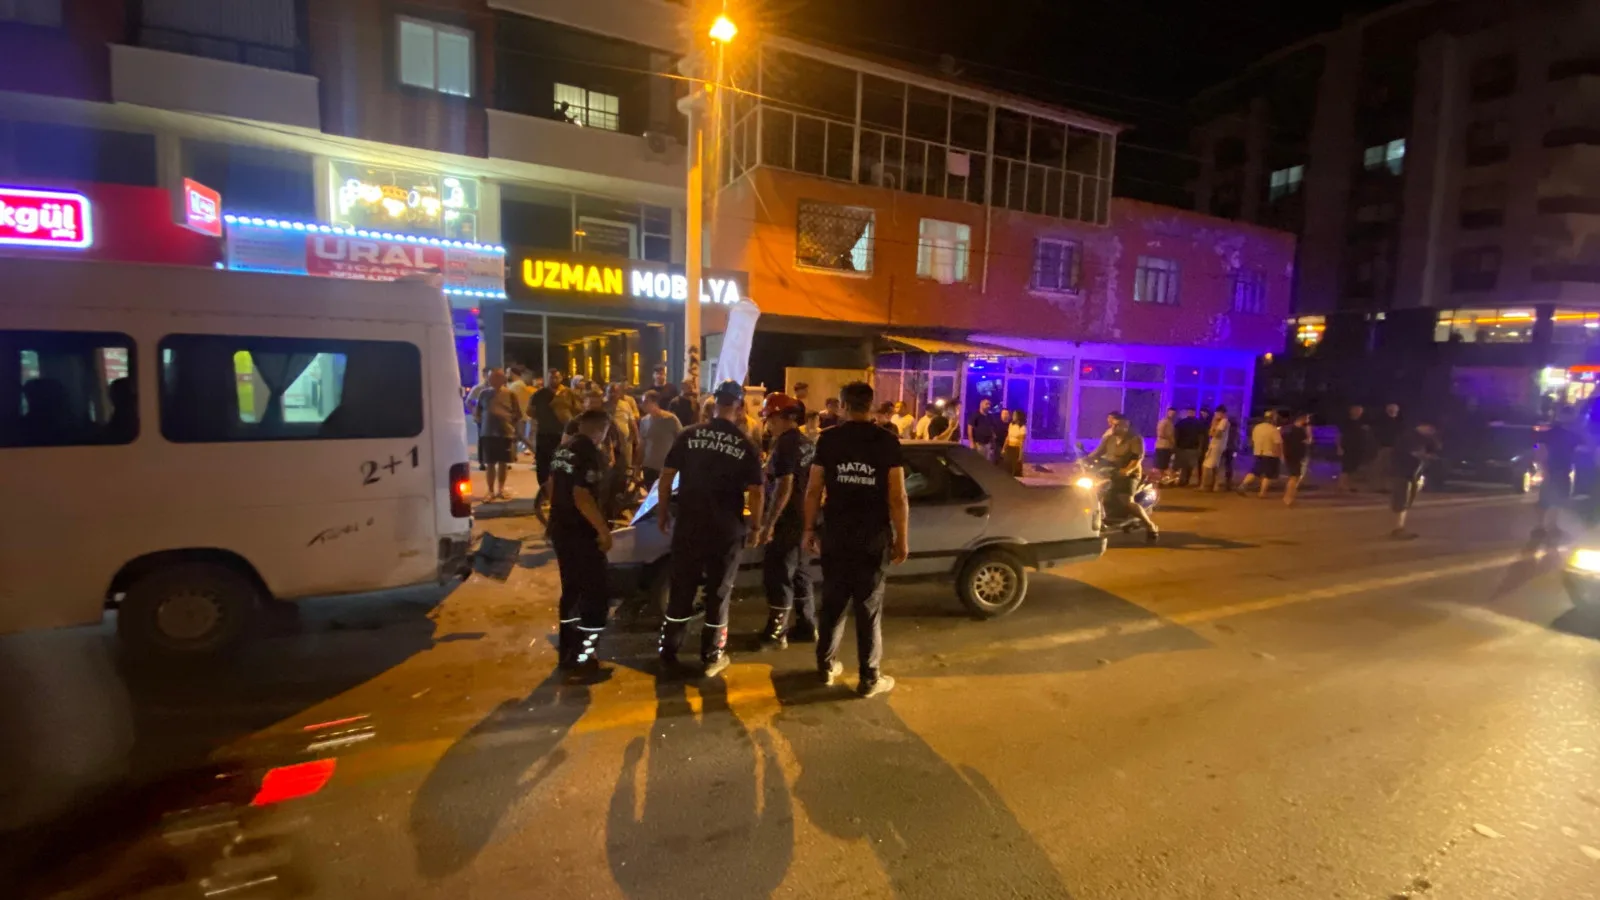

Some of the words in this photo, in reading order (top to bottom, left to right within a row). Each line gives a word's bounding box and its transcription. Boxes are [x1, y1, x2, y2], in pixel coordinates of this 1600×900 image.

[315, 237, 437, 268] URAL
[523, 258, 623, 295] UZMAN
[631, 270, 740, 304] MOBLYA
[696, 428, 742, 445] HATAY
[837, 461, 876, 475] HATAY
